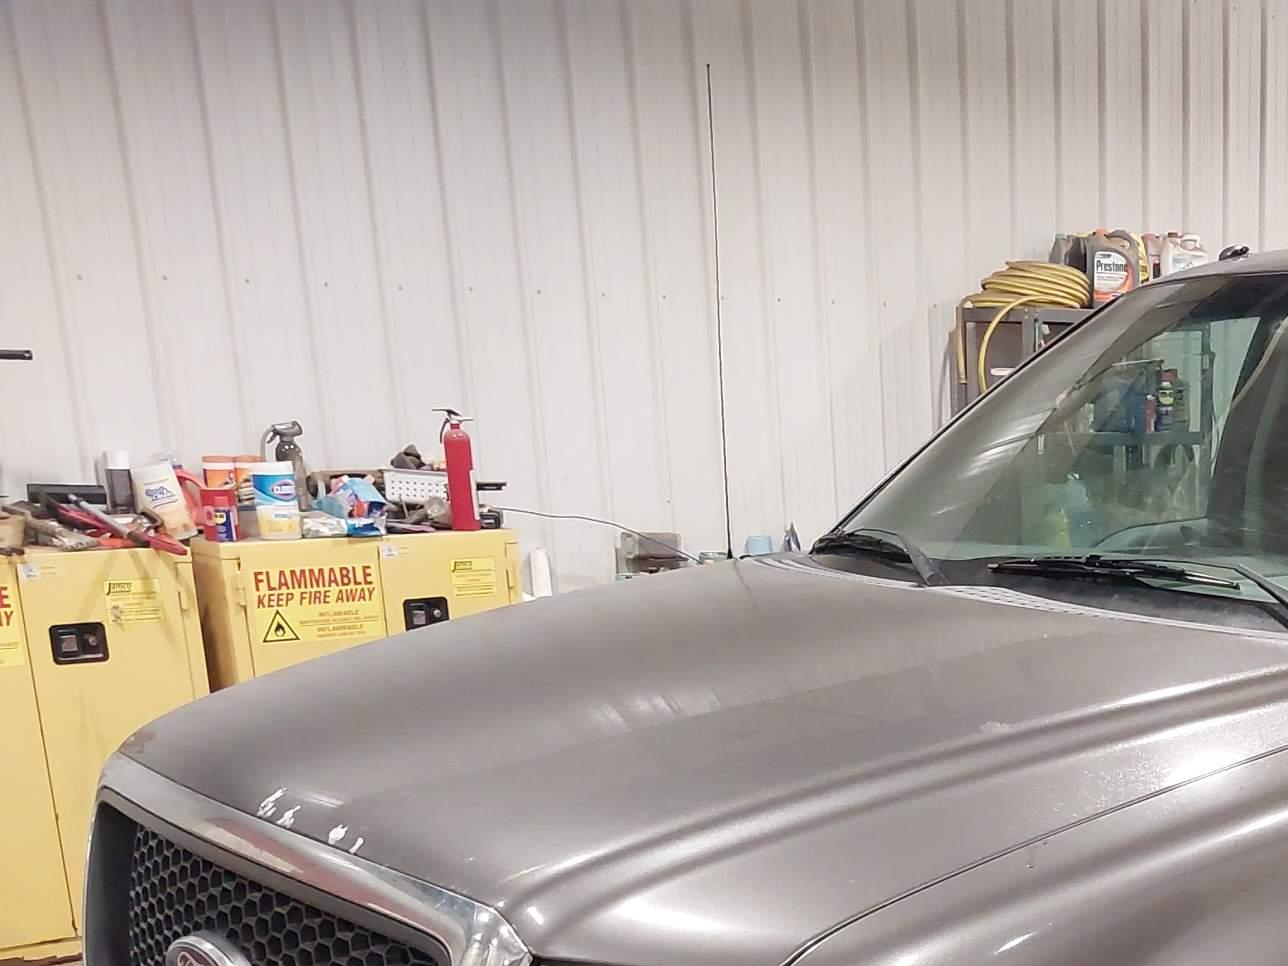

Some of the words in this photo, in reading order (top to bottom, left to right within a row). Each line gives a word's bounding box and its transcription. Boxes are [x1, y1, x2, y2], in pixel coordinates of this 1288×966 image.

[253, 565, 373, 592] FLAMMABLE
[257, 592, 294, 609] KEEP
[299, 590, 331, 606] FIRE
[335, 586, 375, 603] AWAY
